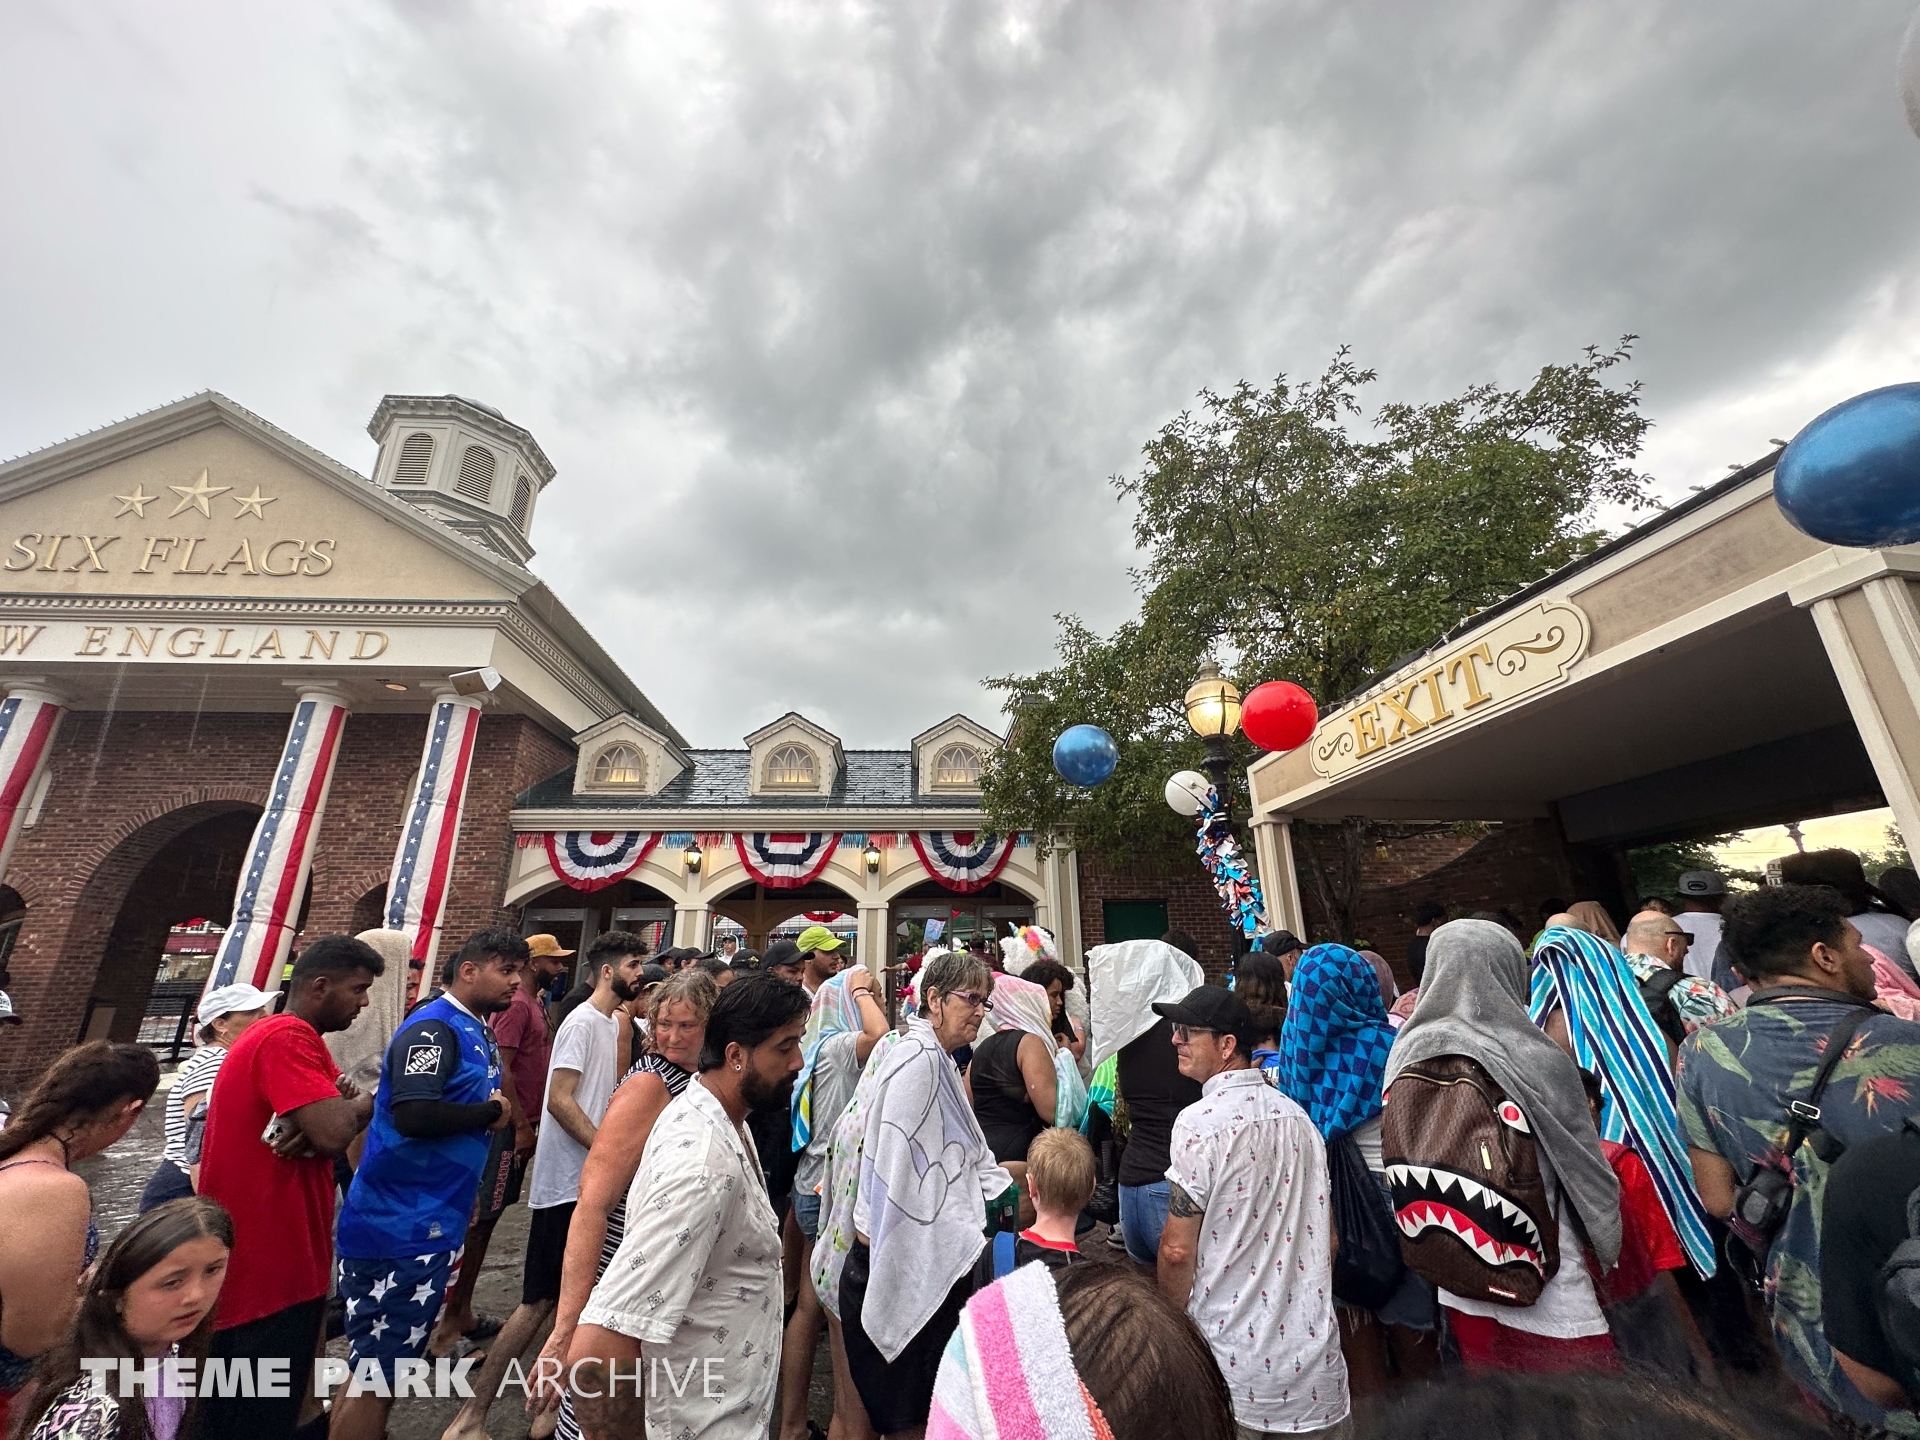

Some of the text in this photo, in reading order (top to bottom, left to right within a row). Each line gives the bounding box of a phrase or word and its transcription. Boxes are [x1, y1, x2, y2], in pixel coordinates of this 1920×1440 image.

[4, 532, 337, 577] SIX FLAGS
[74, 626, 389, 660] ENGLAND
[1348, 642, 1493, 759] EXIT
[407, 1047, 440, 1073] HOME
